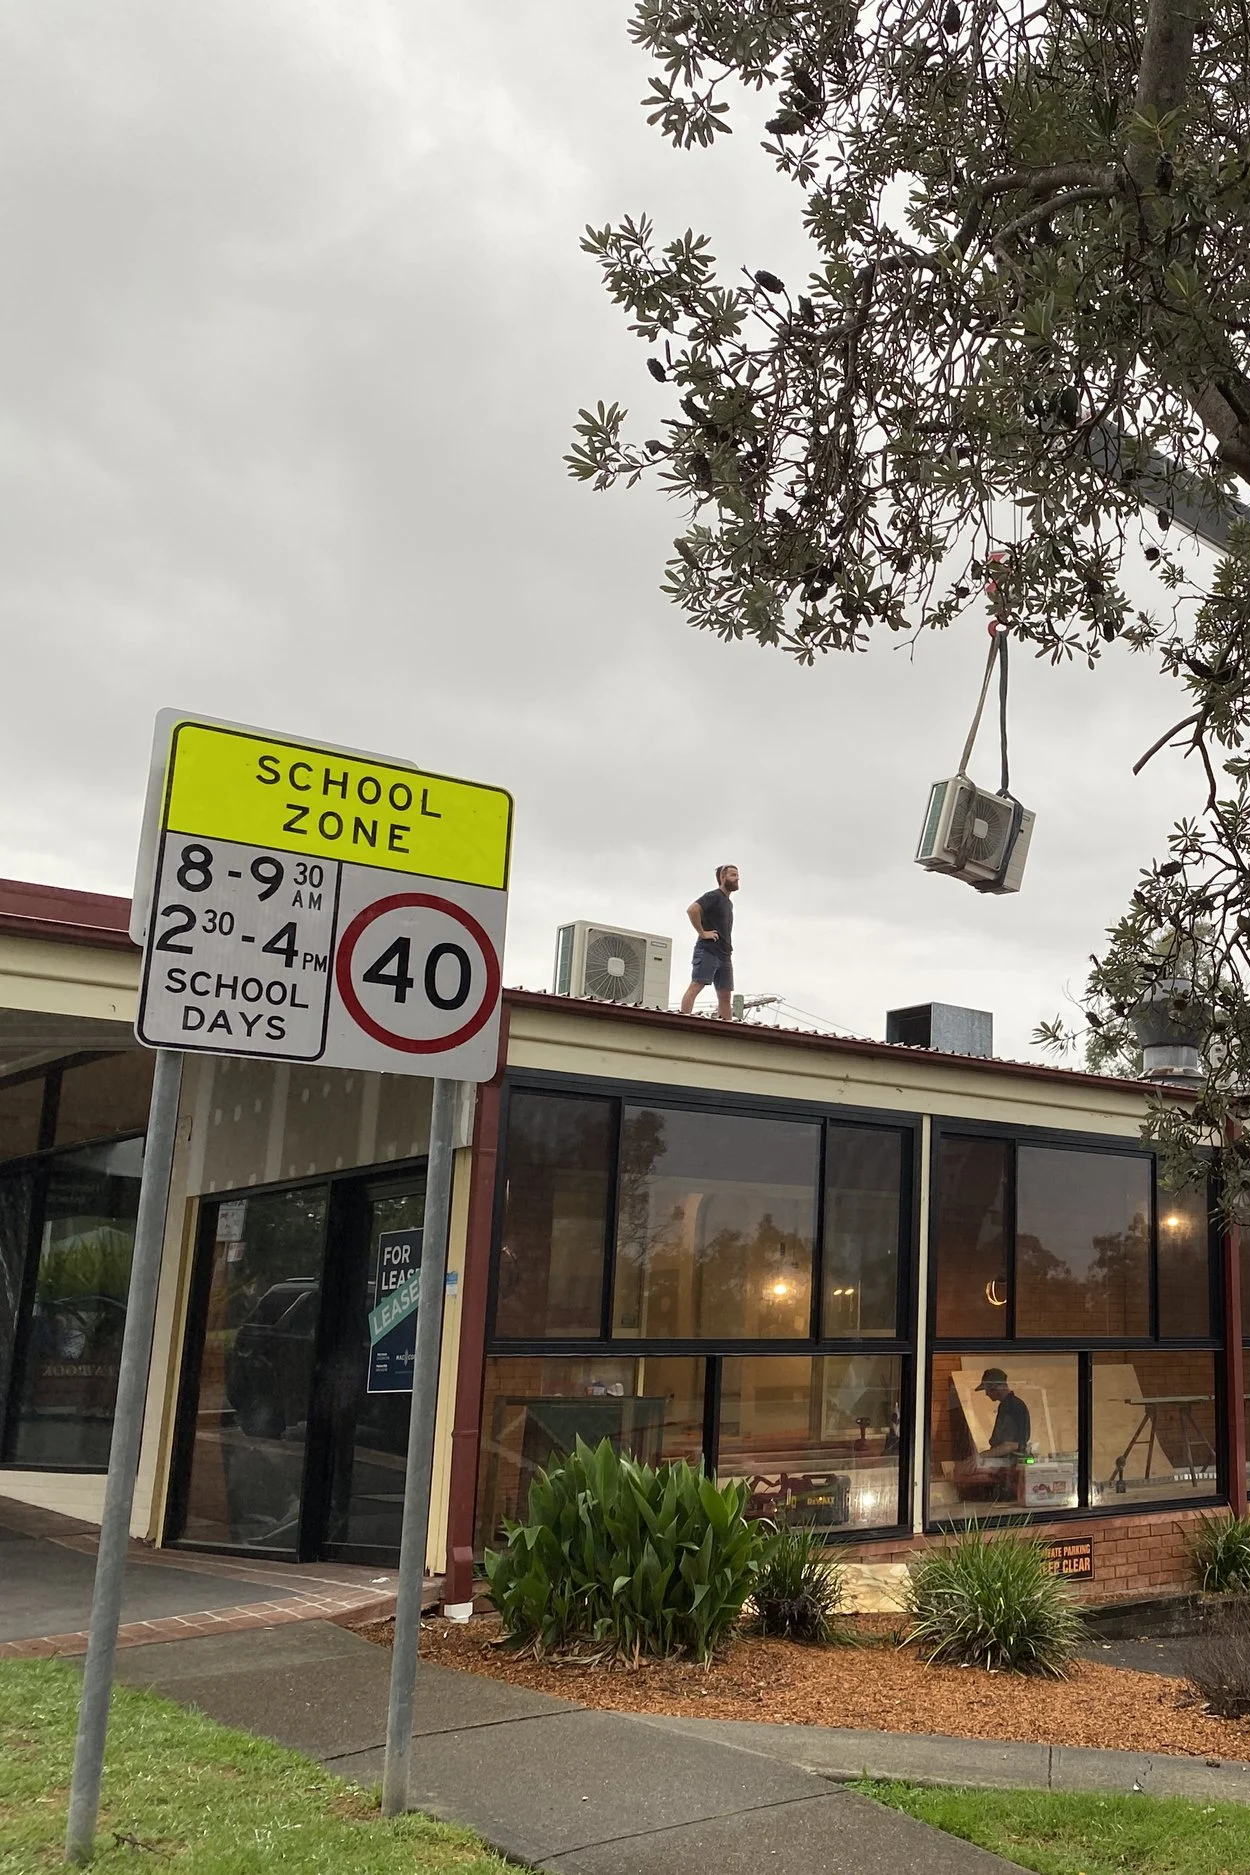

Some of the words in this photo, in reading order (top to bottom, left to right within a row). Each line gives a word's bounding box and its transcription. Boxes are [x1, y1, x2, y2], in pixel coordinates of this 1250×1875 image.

[255, 755, 442, 819] SCHOOL
[282, 803, 412, 854] ZONE
[291, 889, 323, 911] AM
[302, 952, 328, 973] PM
[362, 936, 472, 1011] 40
[164, 967, 309, 1009] SCHOOL
[181, 1005, 287, 1041] DAYS
[383, 1244, 411, 1266] FOR
[381, 1268, 421, 1291] LEAS
[373, 1279, 420, 1335] LEASE
[1063, 1544, 1091, 1557] PARKING
[1040, 1561, 1060, 1577] EEP
[1062, 1557, 1091, 1573] CLEAR
